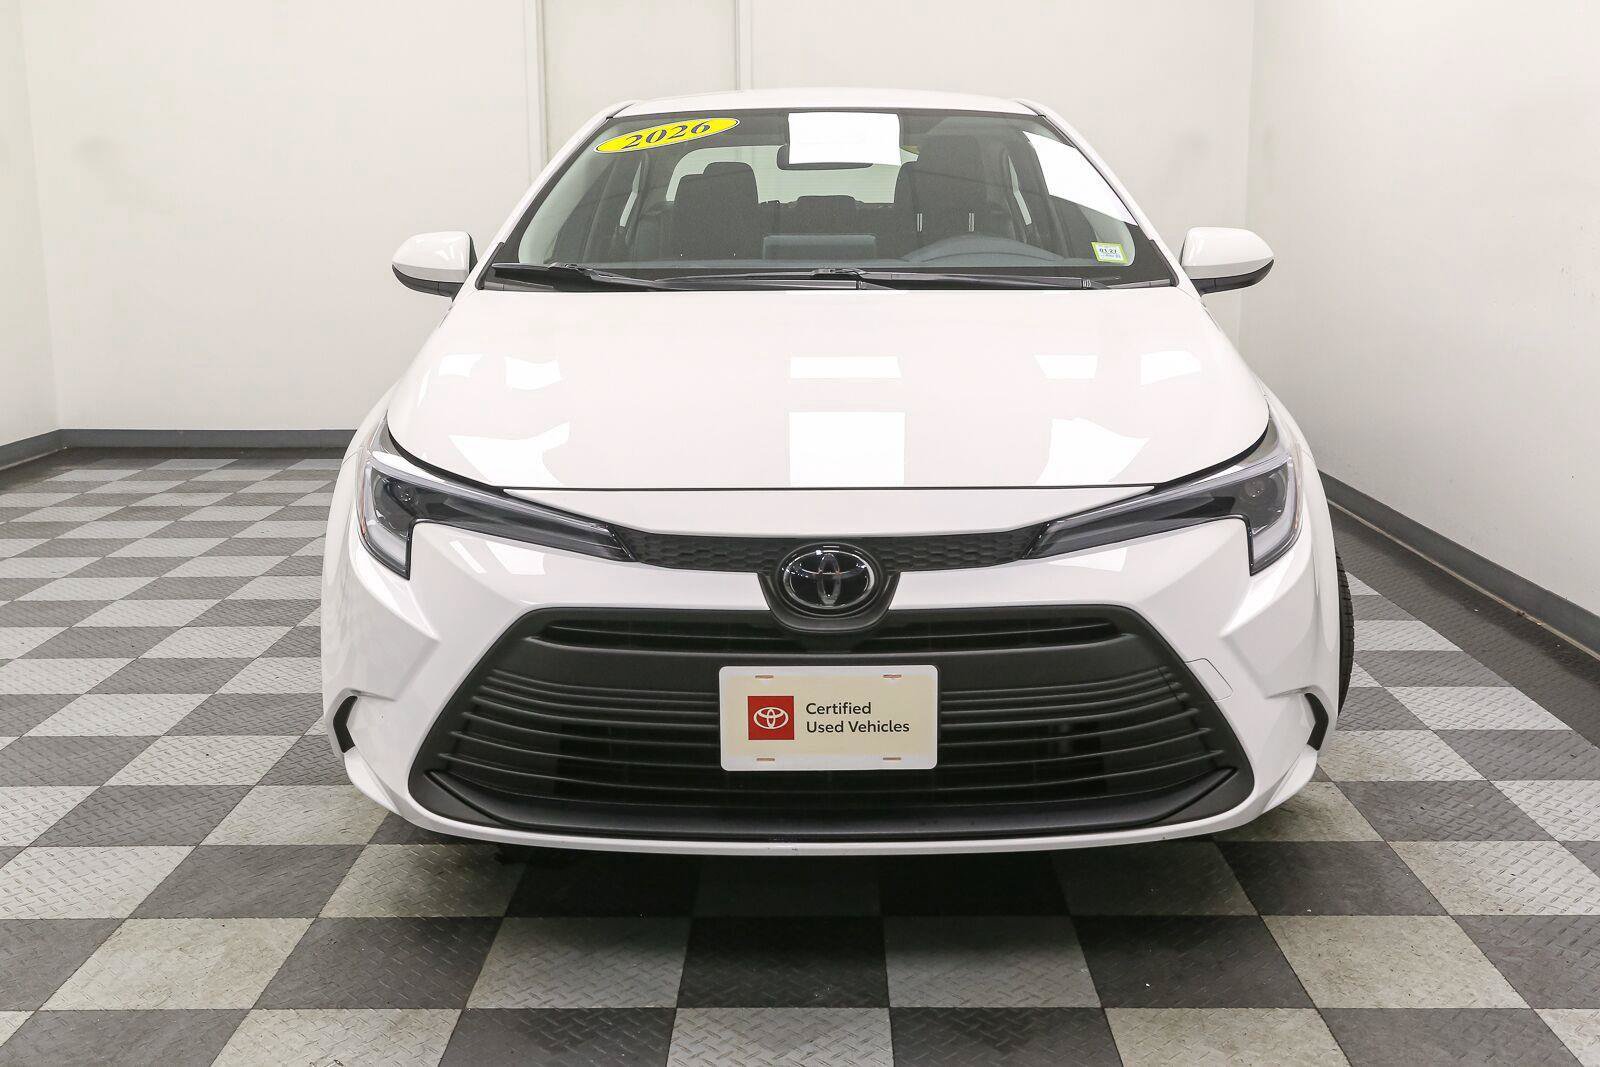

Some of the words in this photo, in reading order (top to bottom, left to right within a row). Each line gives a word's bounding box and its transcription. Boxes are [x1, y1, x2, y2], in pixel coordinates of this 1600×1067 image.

[620, 120, 711, 149] 2026
[806, 702, 871, 715] Certified
[806, 721, 844, 733] Used
[848, 720, 910, 733] Vehicles
